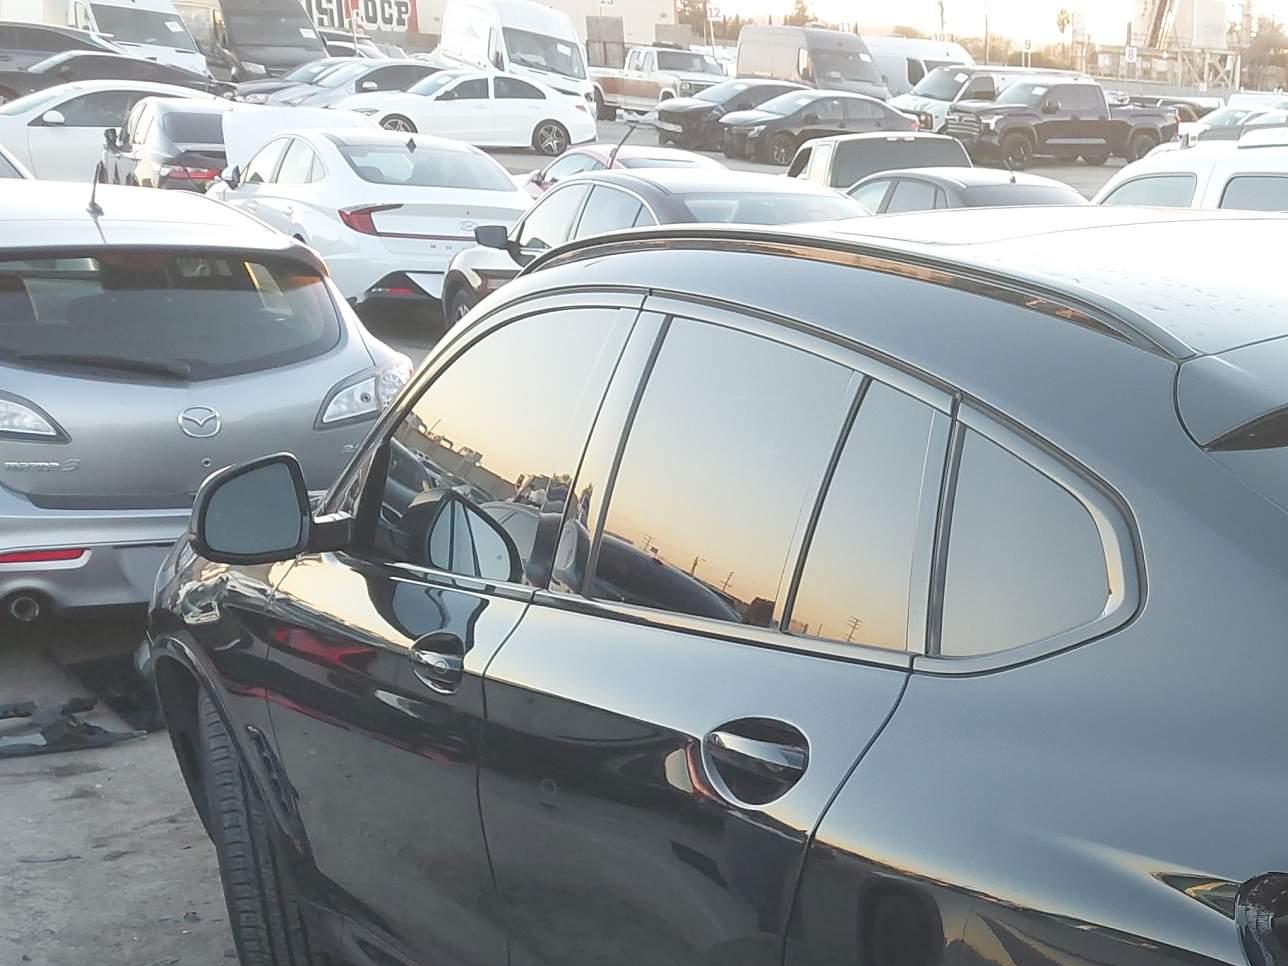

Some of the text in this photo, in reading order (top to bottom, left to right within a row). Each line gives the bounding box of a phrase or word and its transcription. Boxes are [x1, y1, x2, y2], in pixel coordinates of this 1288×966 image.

[708, 7, 721, 18] 12
[1025, 40, 1031, 50] 9
[1128, 49, 1134, 61] 8
